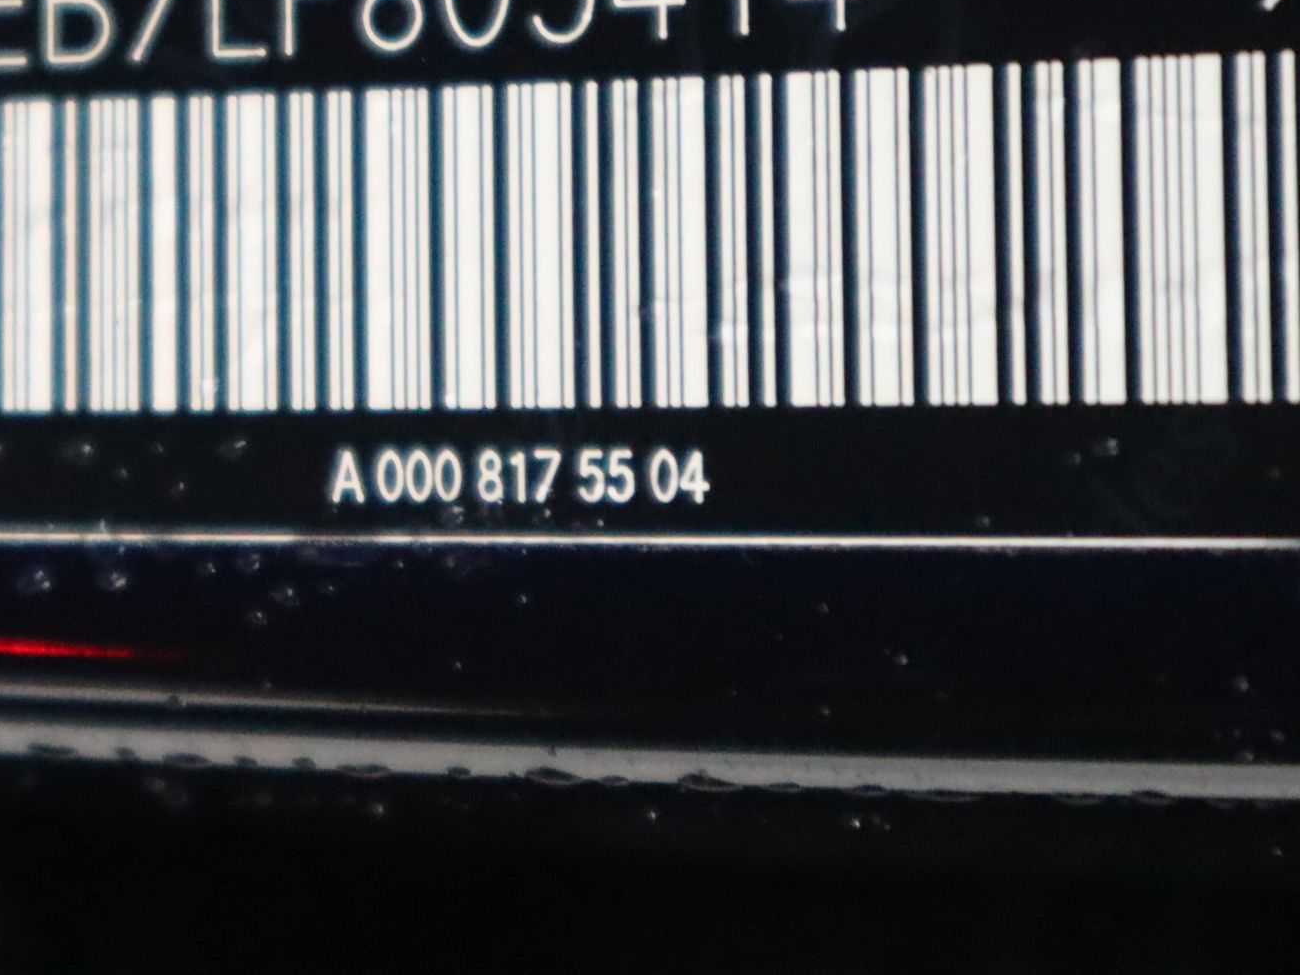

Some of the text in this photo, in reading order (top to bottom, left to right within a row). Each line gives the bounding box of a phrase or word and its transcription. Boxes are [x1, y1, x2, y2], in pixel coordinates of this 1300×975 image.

[331, 449, 710, 504] A 000 817 55 04
